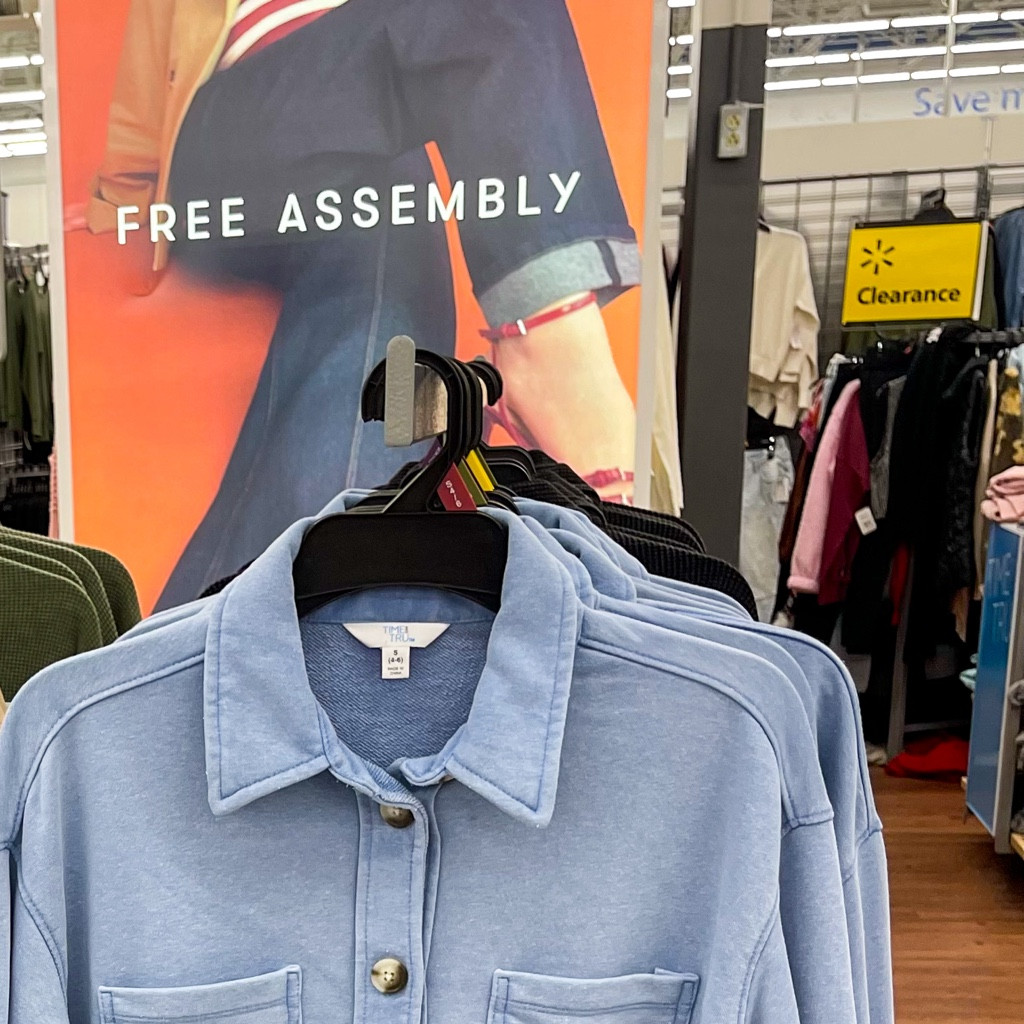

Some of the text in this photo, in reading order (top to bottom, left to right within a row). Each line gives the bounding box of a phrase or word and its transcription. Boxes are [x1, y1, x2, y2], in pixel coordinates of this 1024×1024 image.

[116, 171, 582, 245] FREE ASSEMBLY
[857, 286, 961, 305] Clearance
